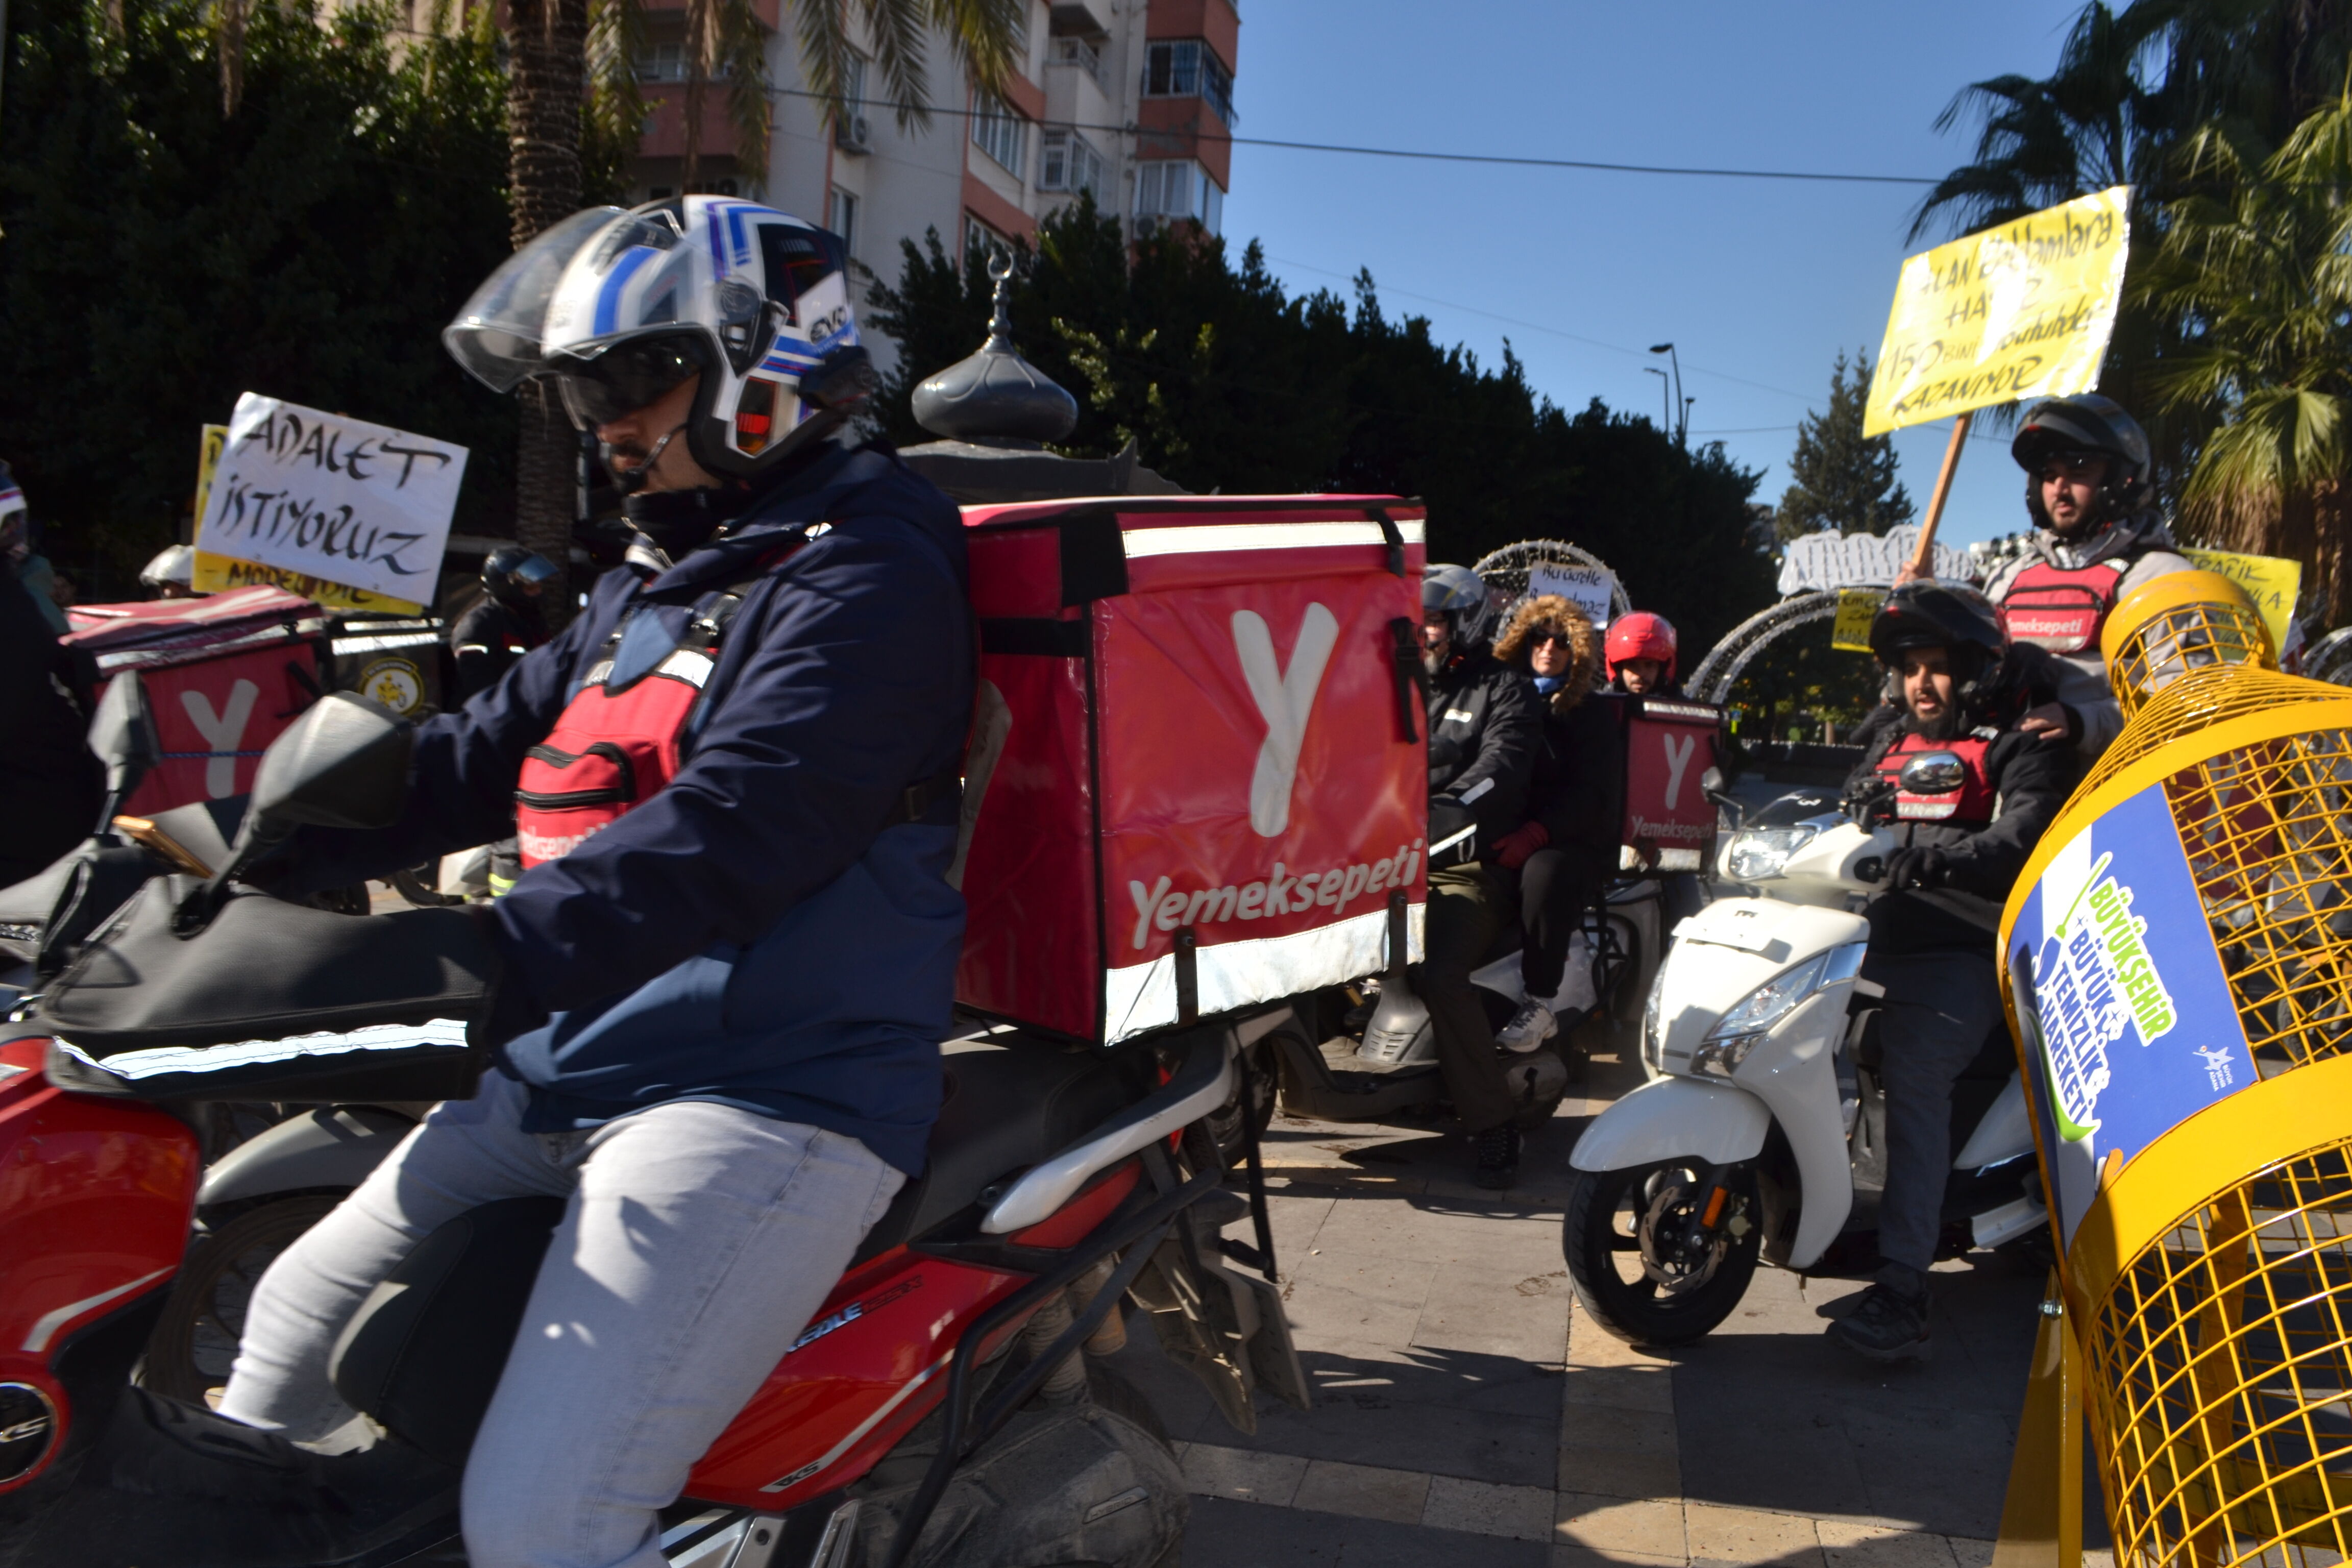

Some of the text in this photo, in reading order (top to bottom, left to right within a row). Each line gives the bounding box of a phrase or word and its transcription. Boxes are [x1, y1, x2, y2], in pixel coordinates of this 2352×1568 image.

[236, 411, 452, 490] ADALET
[1632, 816, 1712, 841] Yemeksepeti
[1129, 837, 1424, 950] Yemeksepeti
[2069, 928, 2116, 1020] BÜYÜK
[2089, 881, 2172, 1040] BÜYÜKŞEHİR
[2040, 997, 2093, 1125] HAREKETİ
[2052, 960, 2103, 1086] TEMİZLİK
